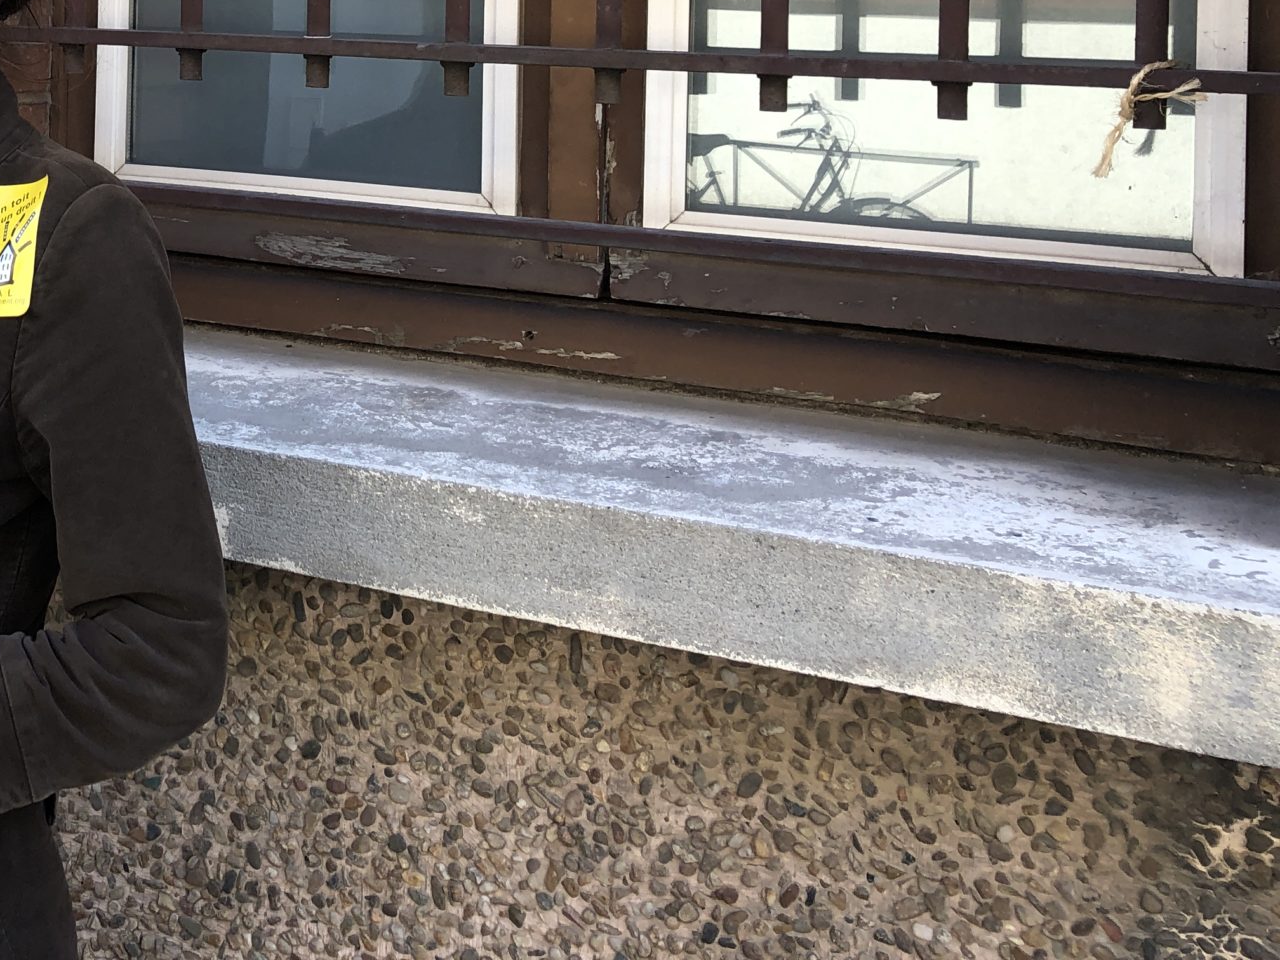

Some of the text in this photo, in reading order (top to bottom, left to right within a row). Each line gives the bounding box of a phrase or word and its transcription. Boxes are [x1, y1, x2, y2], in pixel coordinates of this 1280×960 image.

[1, 213, 13, 224] un
[16, 196, 37, 216] droit
[11, 192, 30, 208] toit
